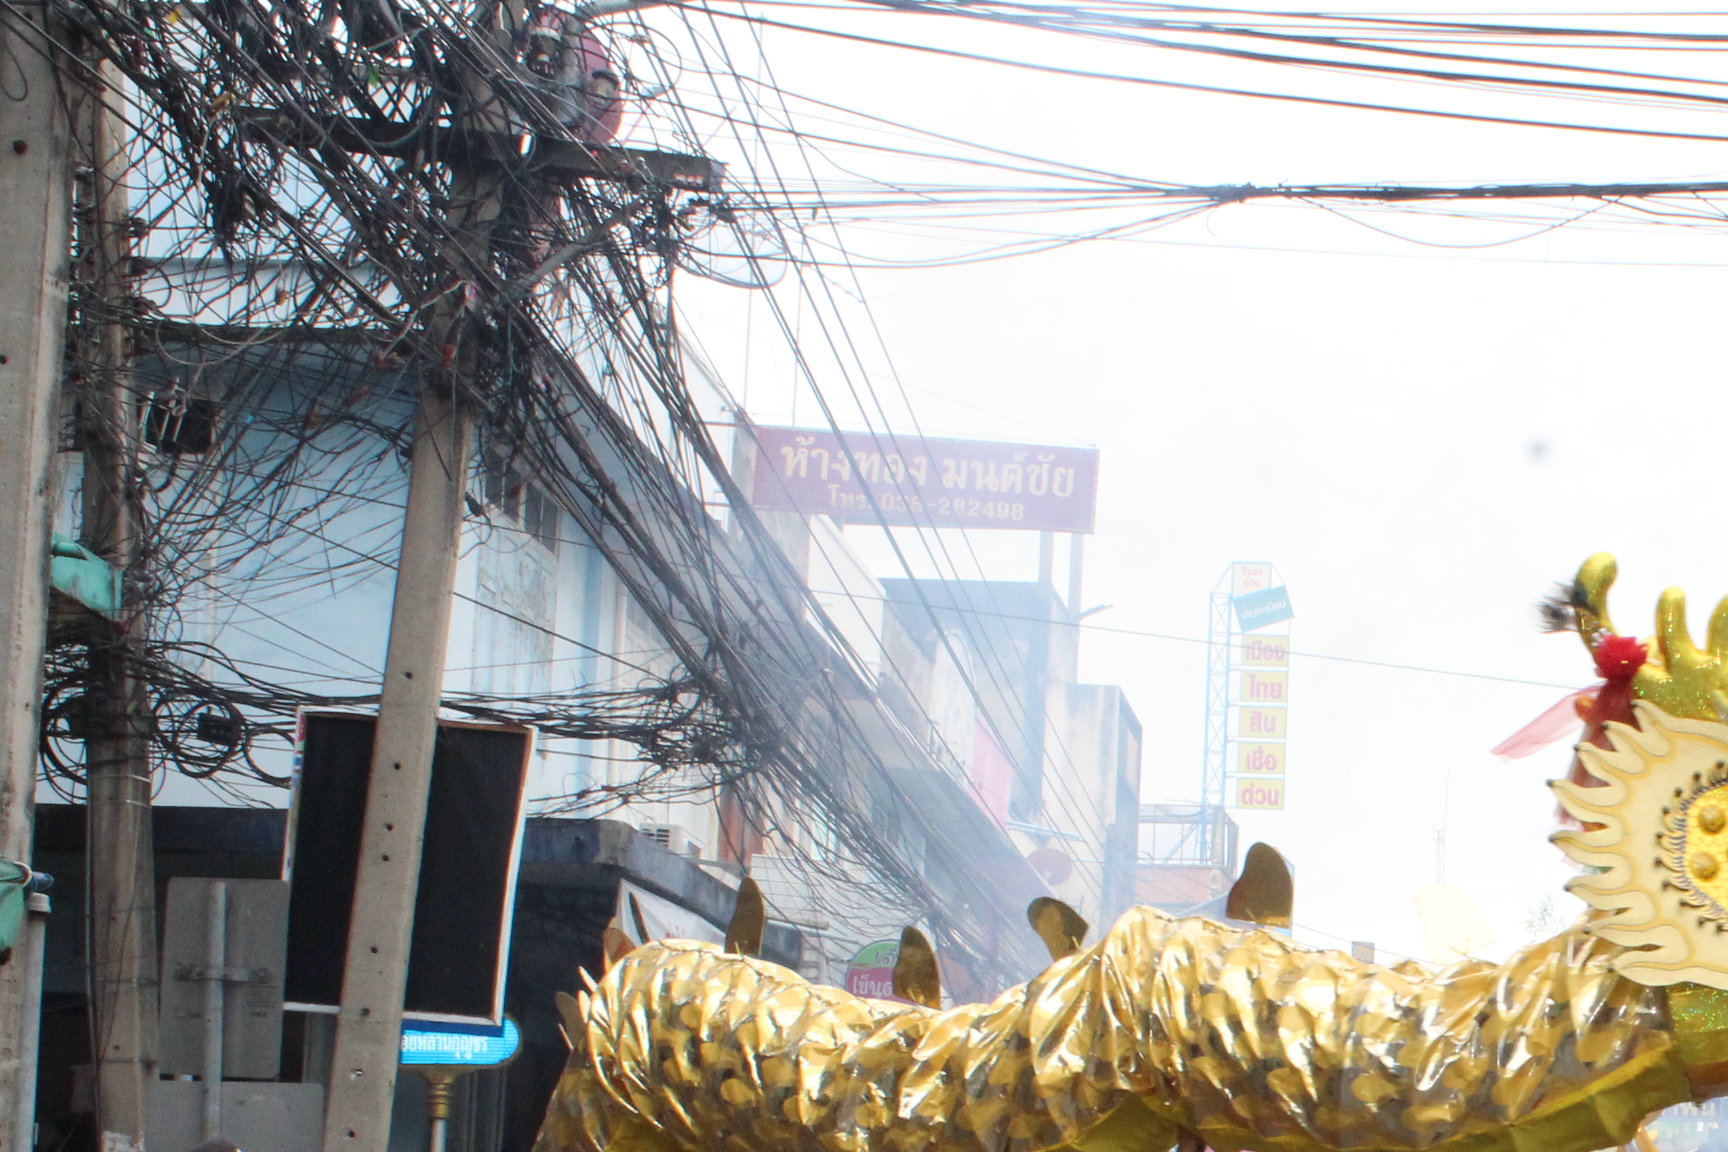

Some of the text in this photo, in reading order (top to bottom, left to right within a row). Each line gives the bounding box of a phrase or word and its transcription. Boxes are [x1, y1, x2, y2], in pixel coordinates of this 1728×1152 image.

[781, 436, 1075, 497] ห้างทอง มนต์ชัย
[1247, 673, 1282, 699] ไทย
[1249, 710, 1276, 733] สิน
[1246, 745, 1277, 772] เชื่อ
[1241, 783, 1280, 806] ด่วน
